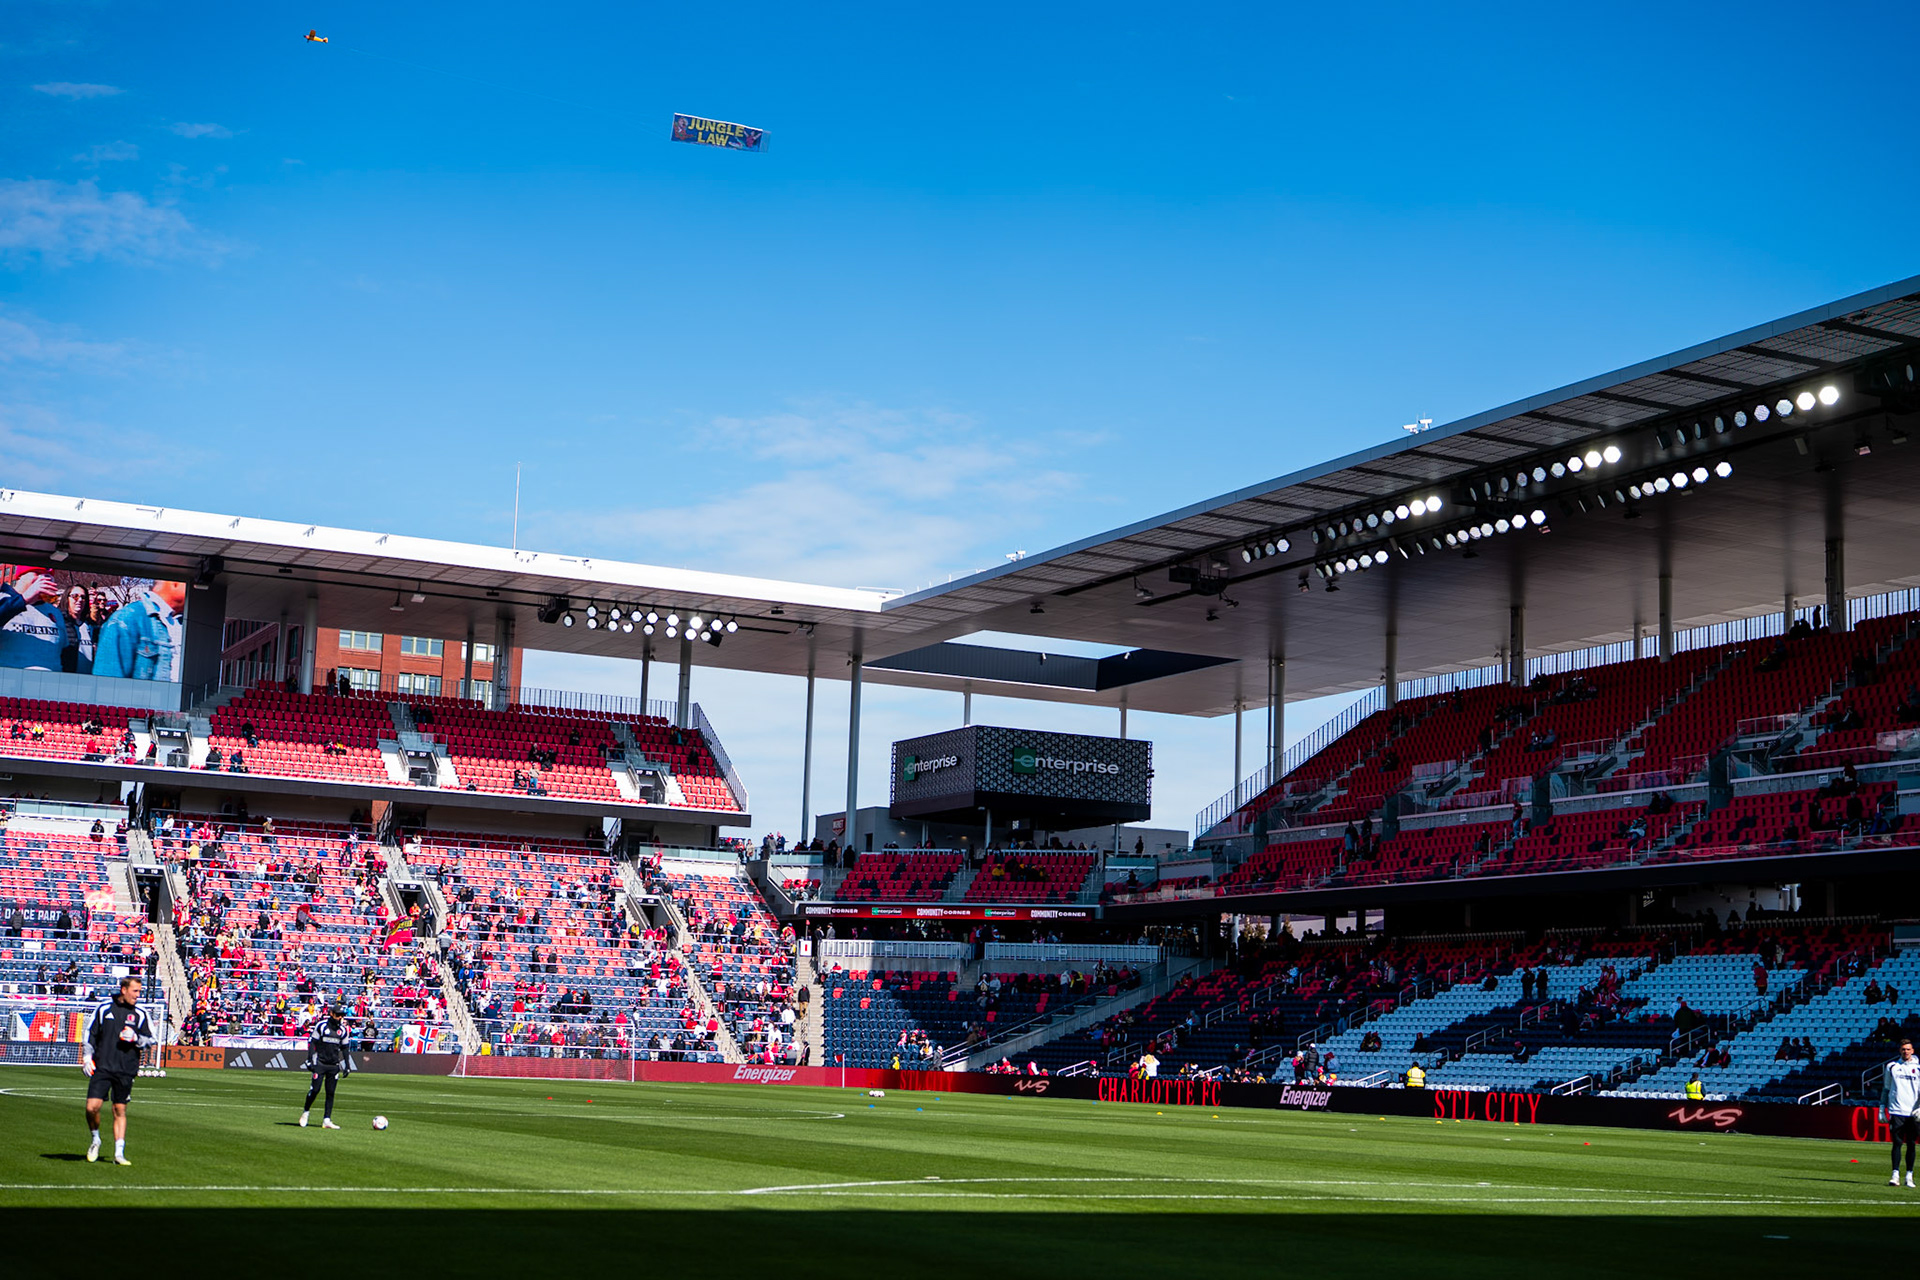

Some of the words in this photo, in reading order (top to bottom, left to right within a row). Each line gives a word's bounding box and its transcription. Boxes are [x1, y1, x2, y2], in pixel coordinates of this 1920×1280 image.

[688, 117, 745, 137] JUNGLE
[697, 131, 729, 147] LAW
[905, 754, 958, 775] enterprise
[1014, 754, 1119, 775] enterprise
[4, 907, 35, 921] DCE
[37, 909, 62, 922] PART
[805, 906, 832, 915] COMMUNITY
[916, 908, 944, 917] COMMUNITY
[1030, 909, 1059, 919] COMMUNITY
[12, 1044, 70, 1058] ULTRA
[186, 1048, 222, 1062] Tire
[733, 1065, 797, 1084] Energizer
[900, 1070, 922, 1091] STL
[1098, 1077, 1195, 1106] CHARLOTTE
[1201, 1081, 1221, 1107] FC
[1279, 1085, 1332, 1110] Energizer
[1434, 1090, 1476, 1120] STL
[1485, 1091, 1542, 1124] CITY
